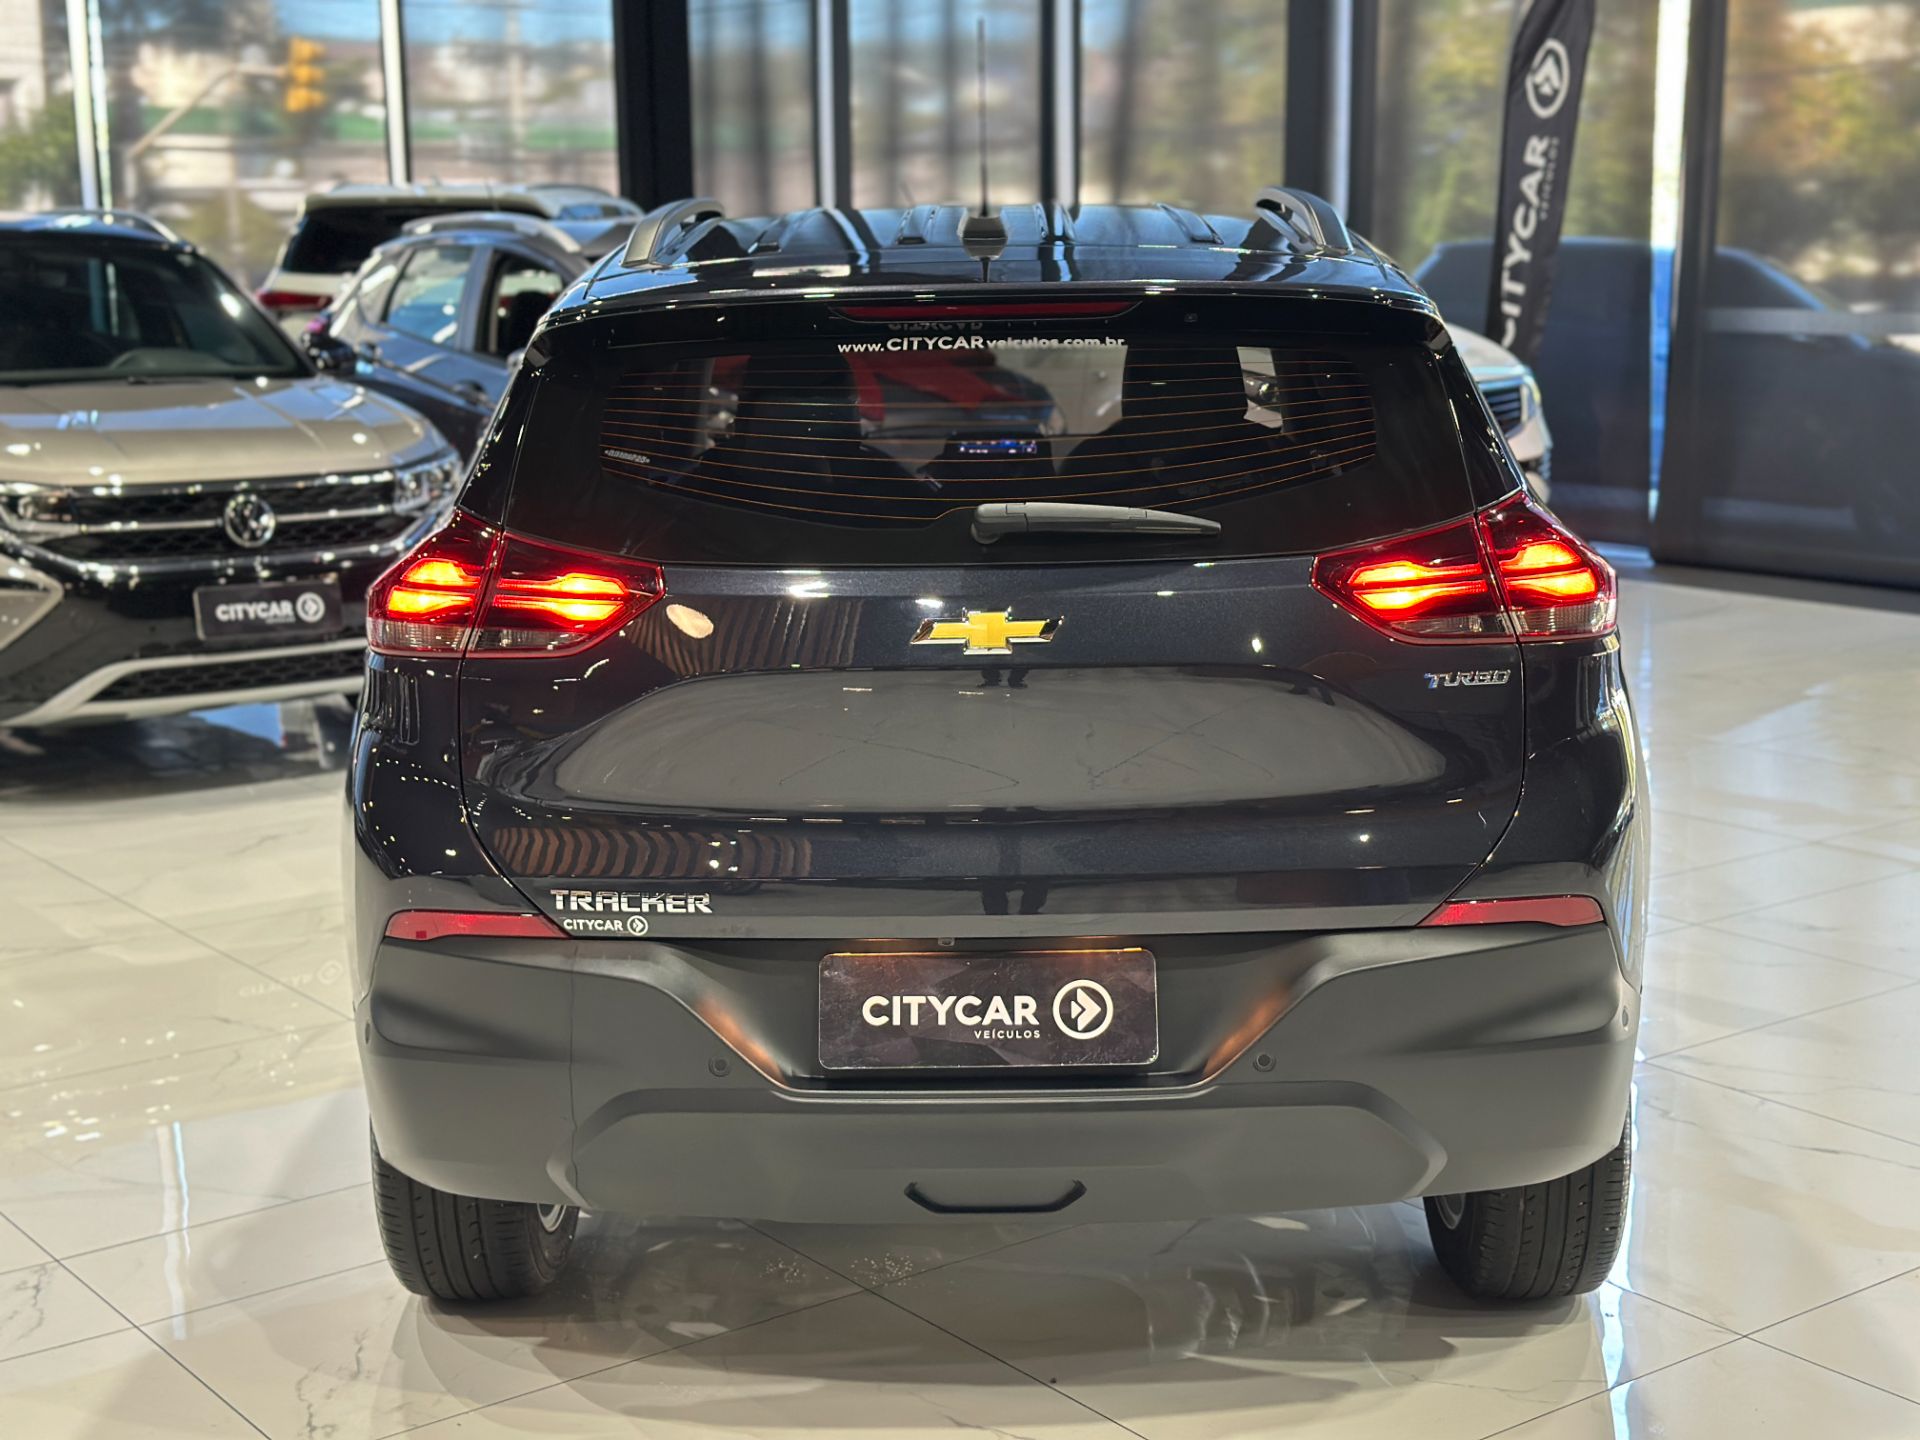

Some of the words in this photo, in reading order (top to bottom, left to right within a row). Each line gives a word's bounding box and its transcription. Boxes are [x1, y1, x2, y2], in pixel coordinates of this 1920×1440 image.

[215, 601, 294, 622] CITYCAR
[1423, 669, 1512, 689] TURBO
[550, 889, 713, 913] TRACKER
[563, 919, 624, 931] CITYCAR
[862, 995, 1039, 1027] CITYCAR
[974, 1028, 1041, 1039] VEÍCULOS
